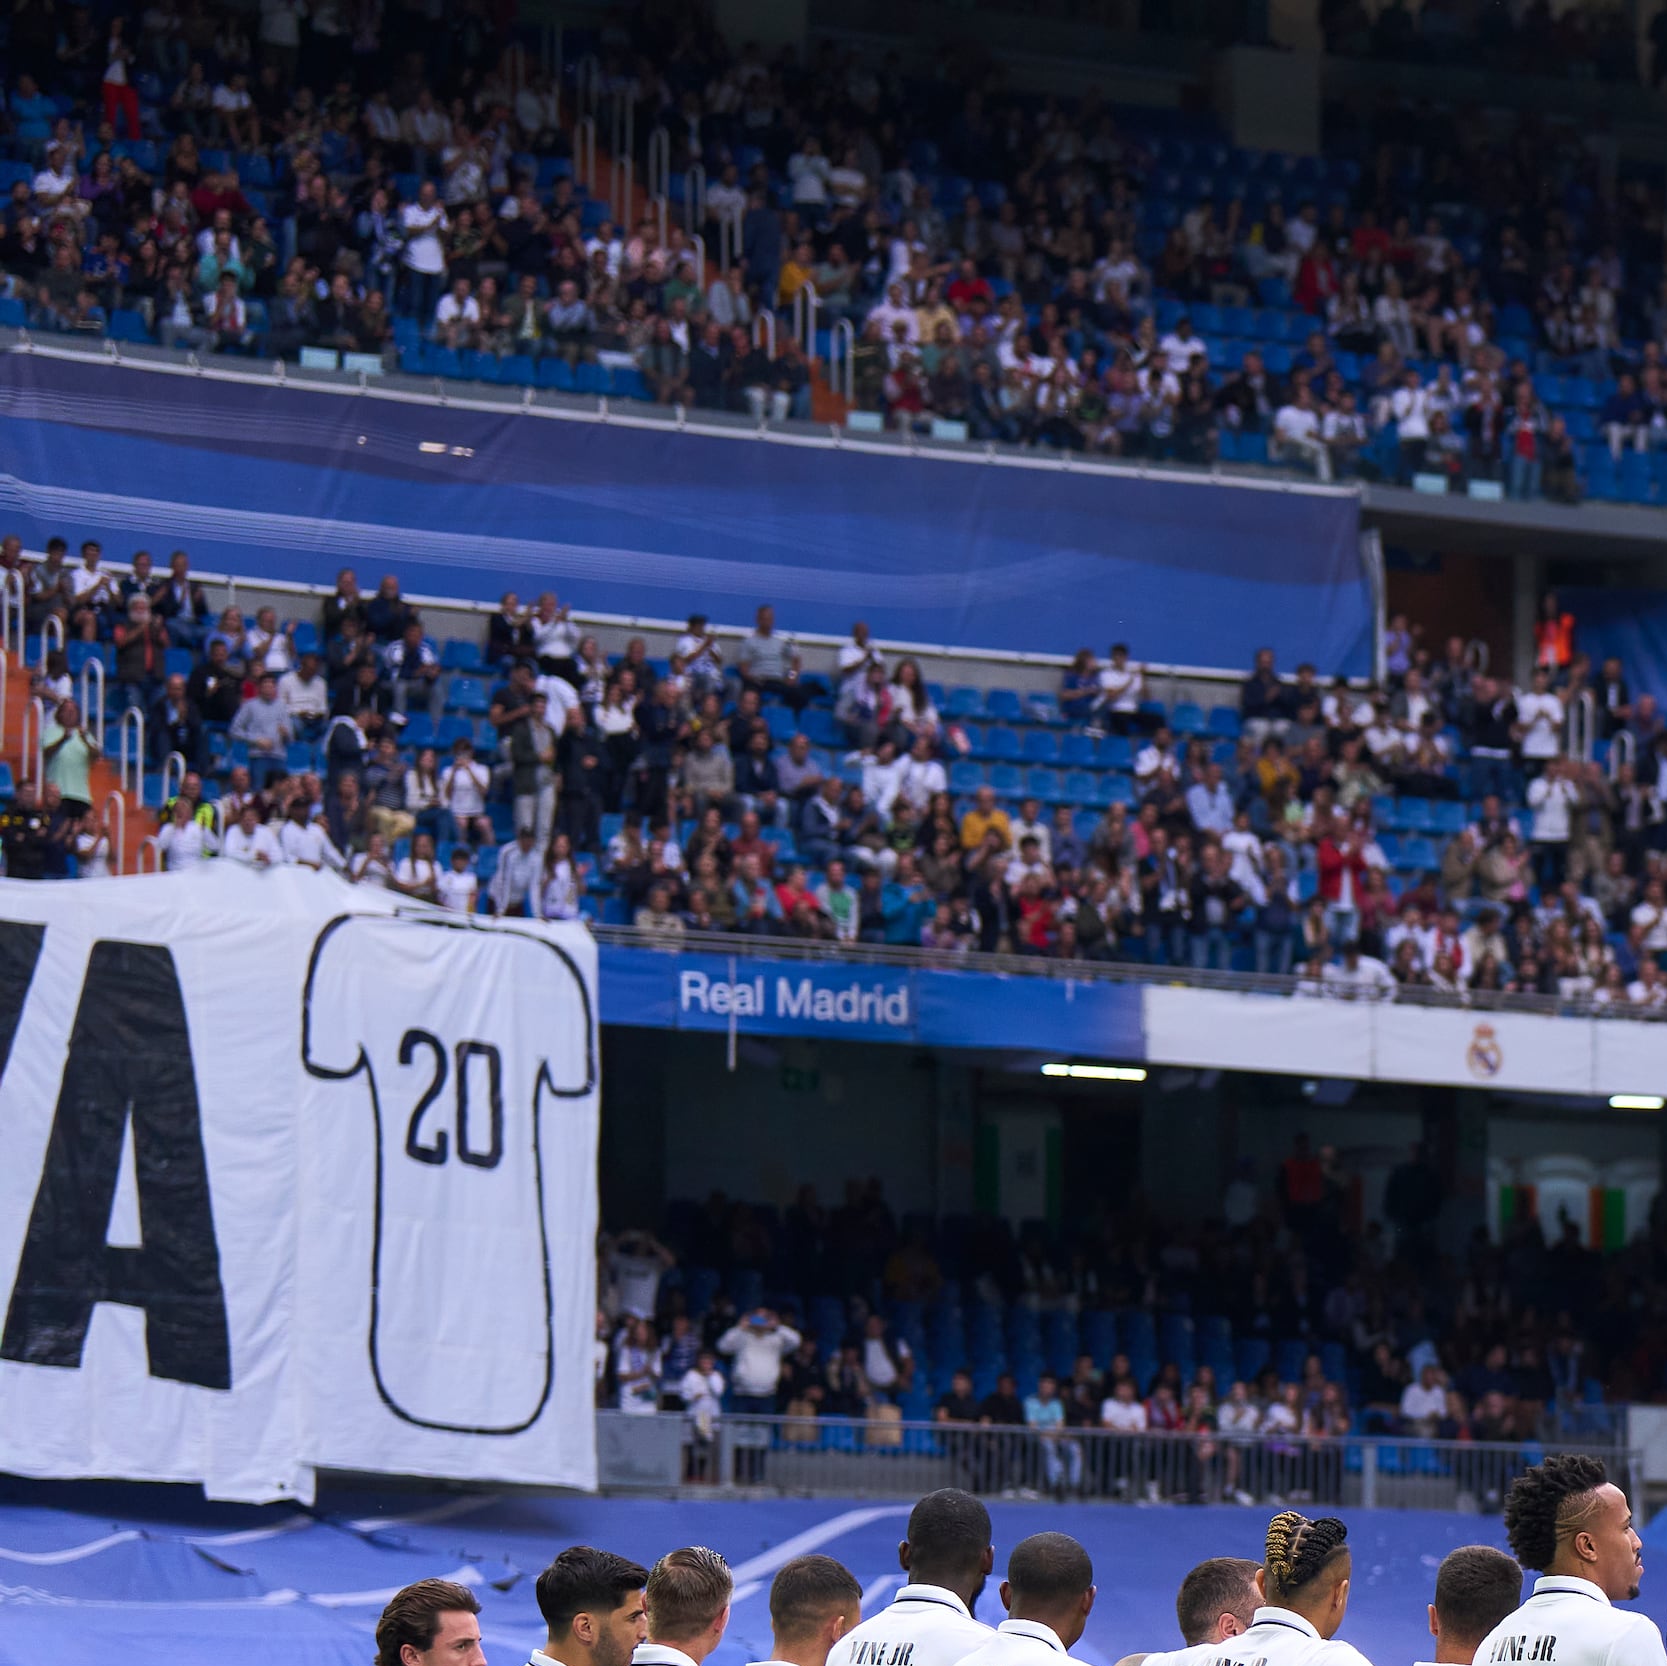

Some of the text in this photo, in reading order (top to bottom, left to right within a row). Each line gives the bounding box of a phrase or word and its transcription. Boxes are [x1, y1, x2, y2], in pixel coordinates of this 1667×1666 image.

[680, 970, 910, 1027] Real Madrid
[398, 1028, 505, 1169] 20
[849, 1641, 913, 1666] VINI JR.
[1490, 1635, 1556, 1663] VINI JR.
